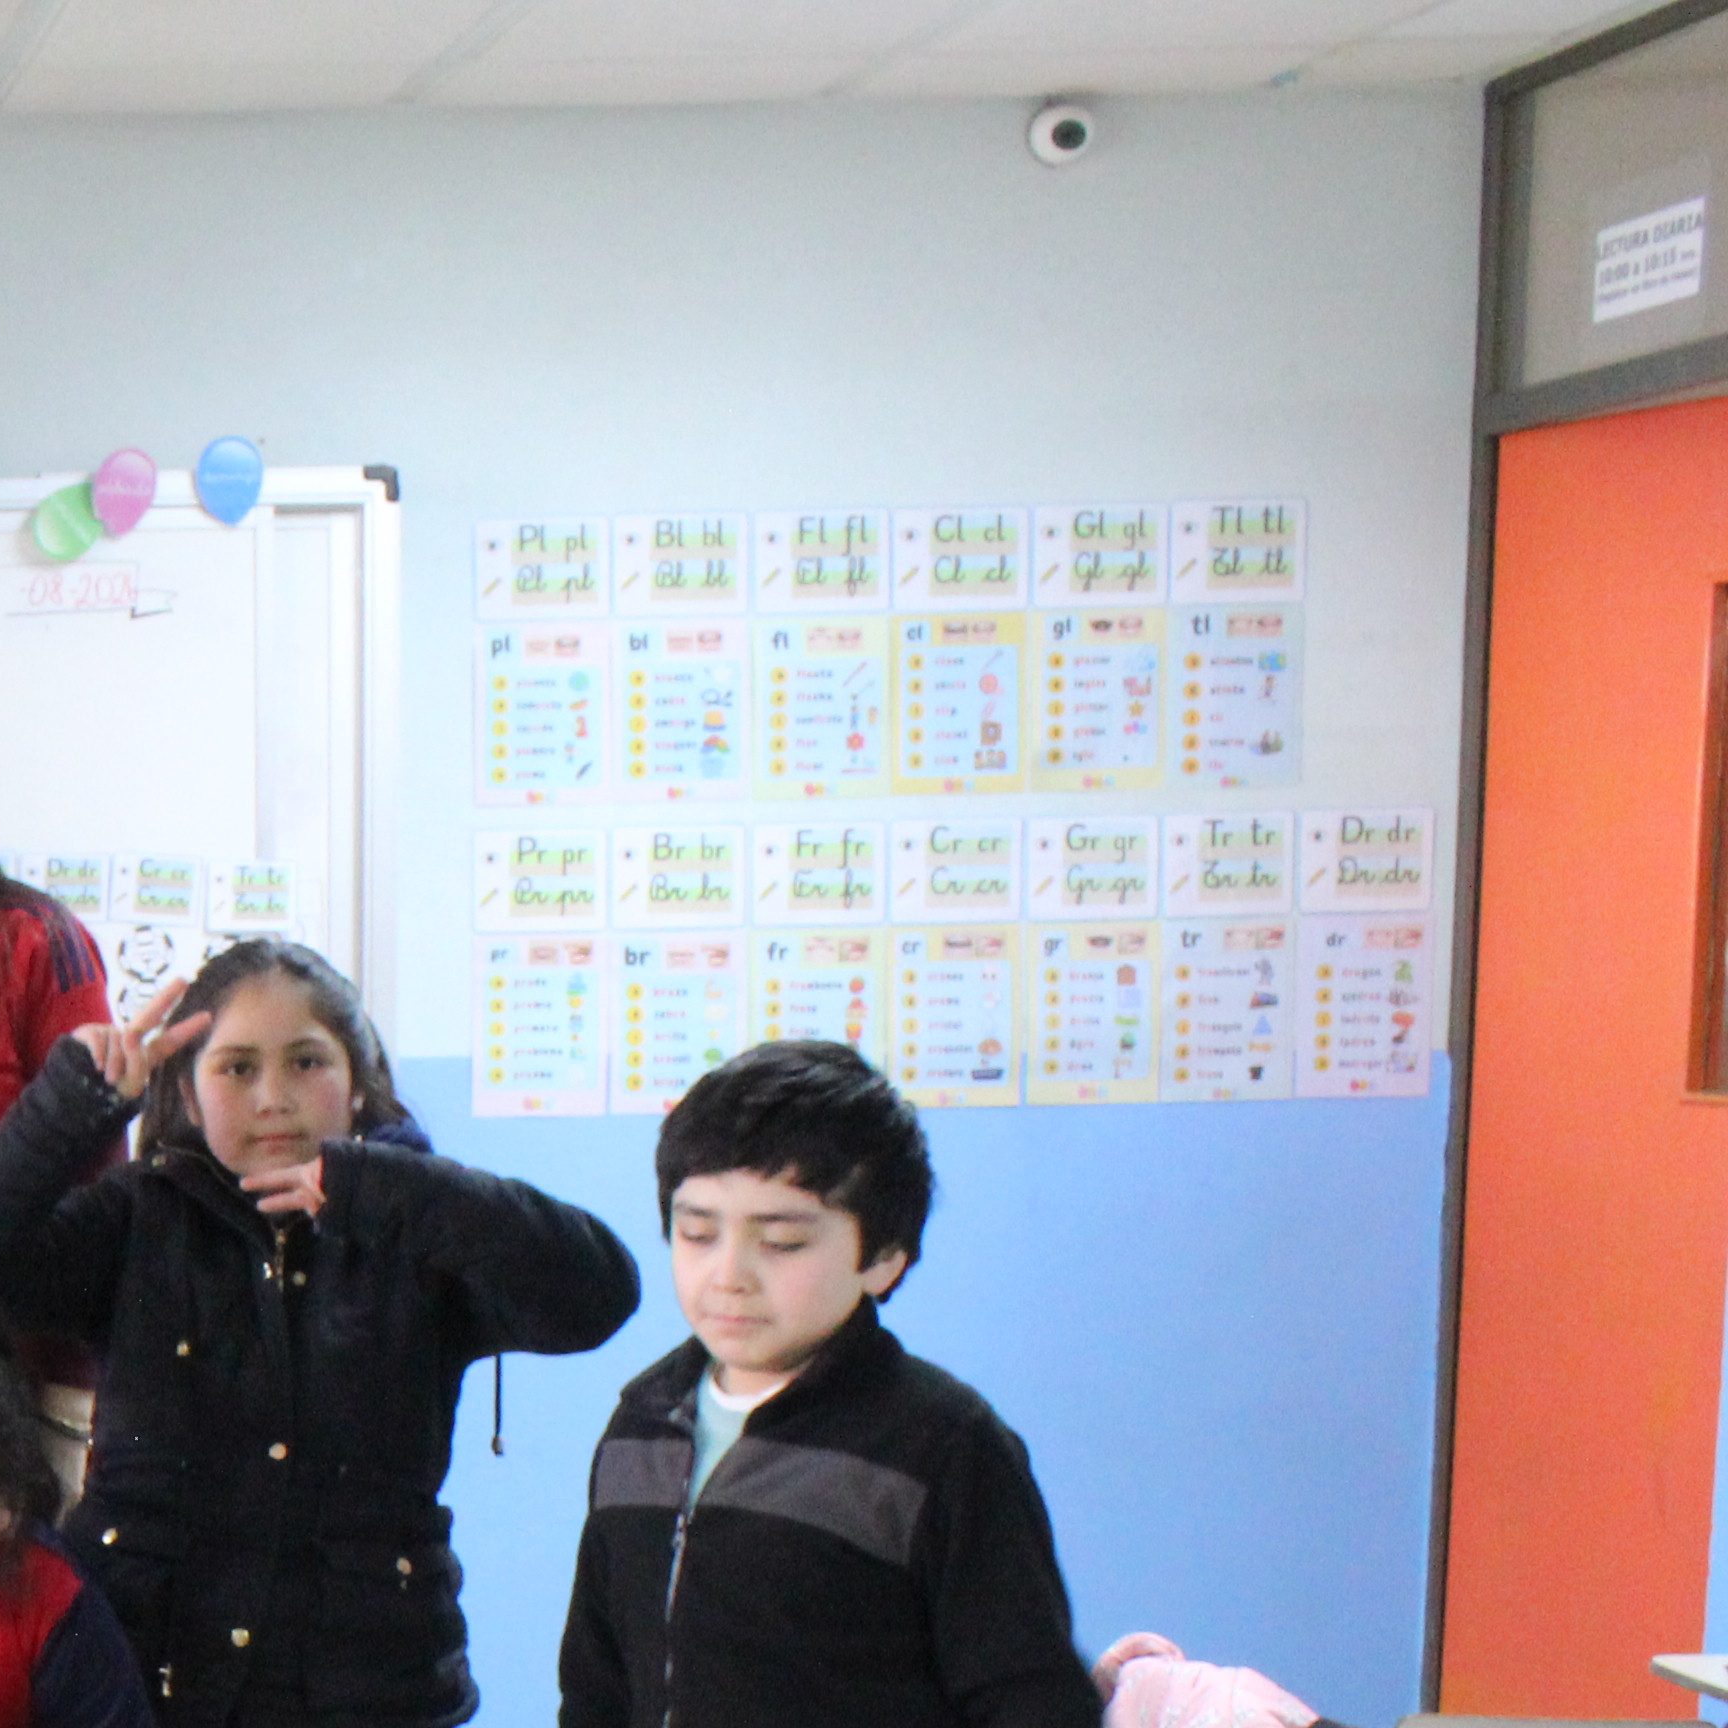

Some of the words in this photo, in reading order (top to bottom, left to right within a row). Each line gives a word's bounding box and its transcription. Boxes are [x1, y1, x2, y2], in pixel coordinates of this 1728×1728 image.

[655, 517, 683, 548] Bl
[703, 516, 724, 547] bl
[798, 514, 826, 545] Fl
[842, 513, 868, 556] fl
[933, 513, 964, 543] Cl
[983, 513, 1004, 543] cl
[1073, 509, 1104, 540] Gl
[1123, 509, 1144, 551] gl
[1213, 506, 1242, 536] Tl
[1262, 503, 1284, 536] tl
[518, 522, 547, 553] Pl
[565, 524, 587, 563] pl
[1053, 615, 1072, 641] gl
[1192, 613, 1211, 636] tl
[490, 634, 511, 658] pl
[629, 632, 648, 653] bl
[930, 825, 963, 855] Cr
[978, 833, 1003, 854] cr
[1065, 824, 1100, 852] Gr
[1113, 832, 1139, 865] gr
[1204, 818, 1233, 847] Tr
[1251, 816, 1276, 846] tr
[1341, 816, 1375, 845] Dr
[1388, 816, 1416, 844] dr
[518, 836, 548, 865] Pr
[562, 842, 588, 876] pr
[653, 833, 686, 861] Br
[700, 832, 726, 861] br
[796, 830, 823, 858] Fr
[838, 826, 867, 869] fr
[768, 941, 788, 961] fr
[901, 940, 922, 956] cr
[1180, 930, 1202, 949] tr
[624, 945, 651, 965] br
